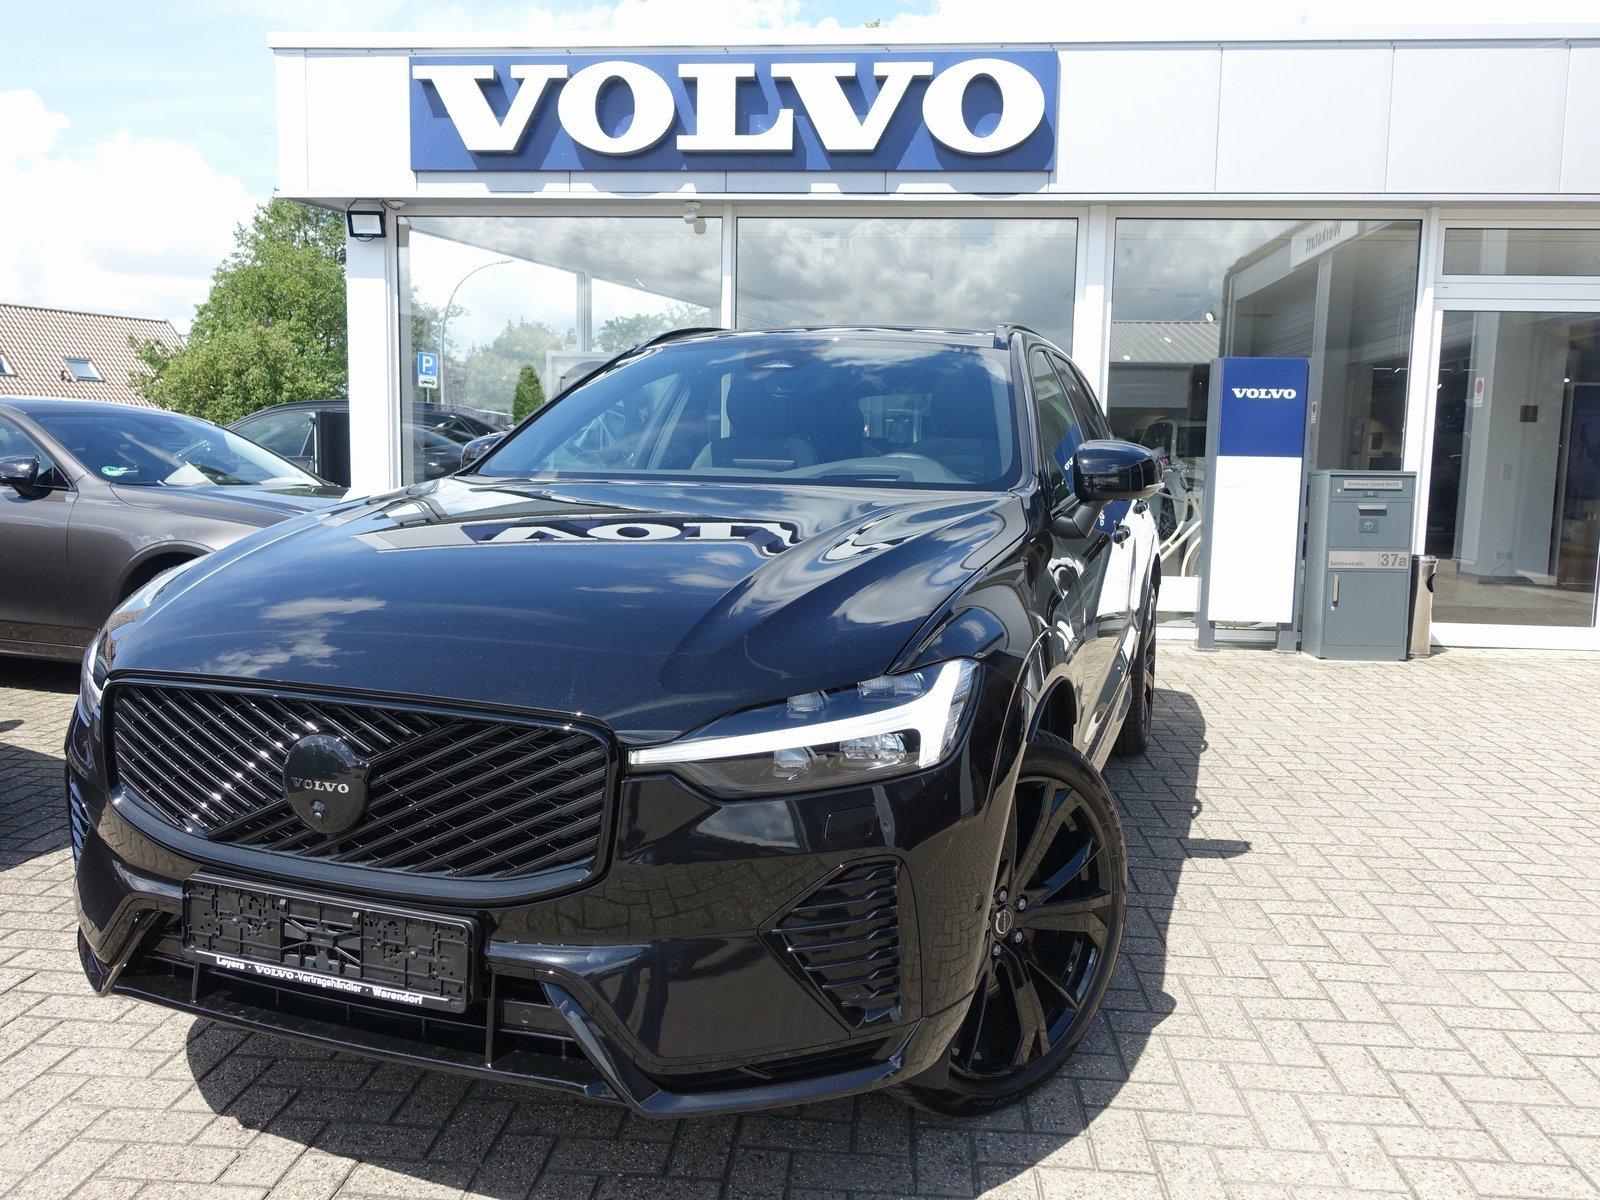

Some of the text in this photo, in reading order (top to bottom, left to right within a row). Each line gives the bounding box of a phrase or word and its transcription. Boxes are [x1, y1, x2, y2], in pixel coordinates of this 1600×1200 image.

[412, 57, 1046, 155] VOLVO
[422, 355, 434, 373] P
[1231, 387, 1297, 400] VOLVO
[1380, 553, 1407, 567] 37a
[291, 776, 350, 794] VOLVO
[216, 956, 245, 970] Leyers
[372, 987, 423, 1005] Warendorf
